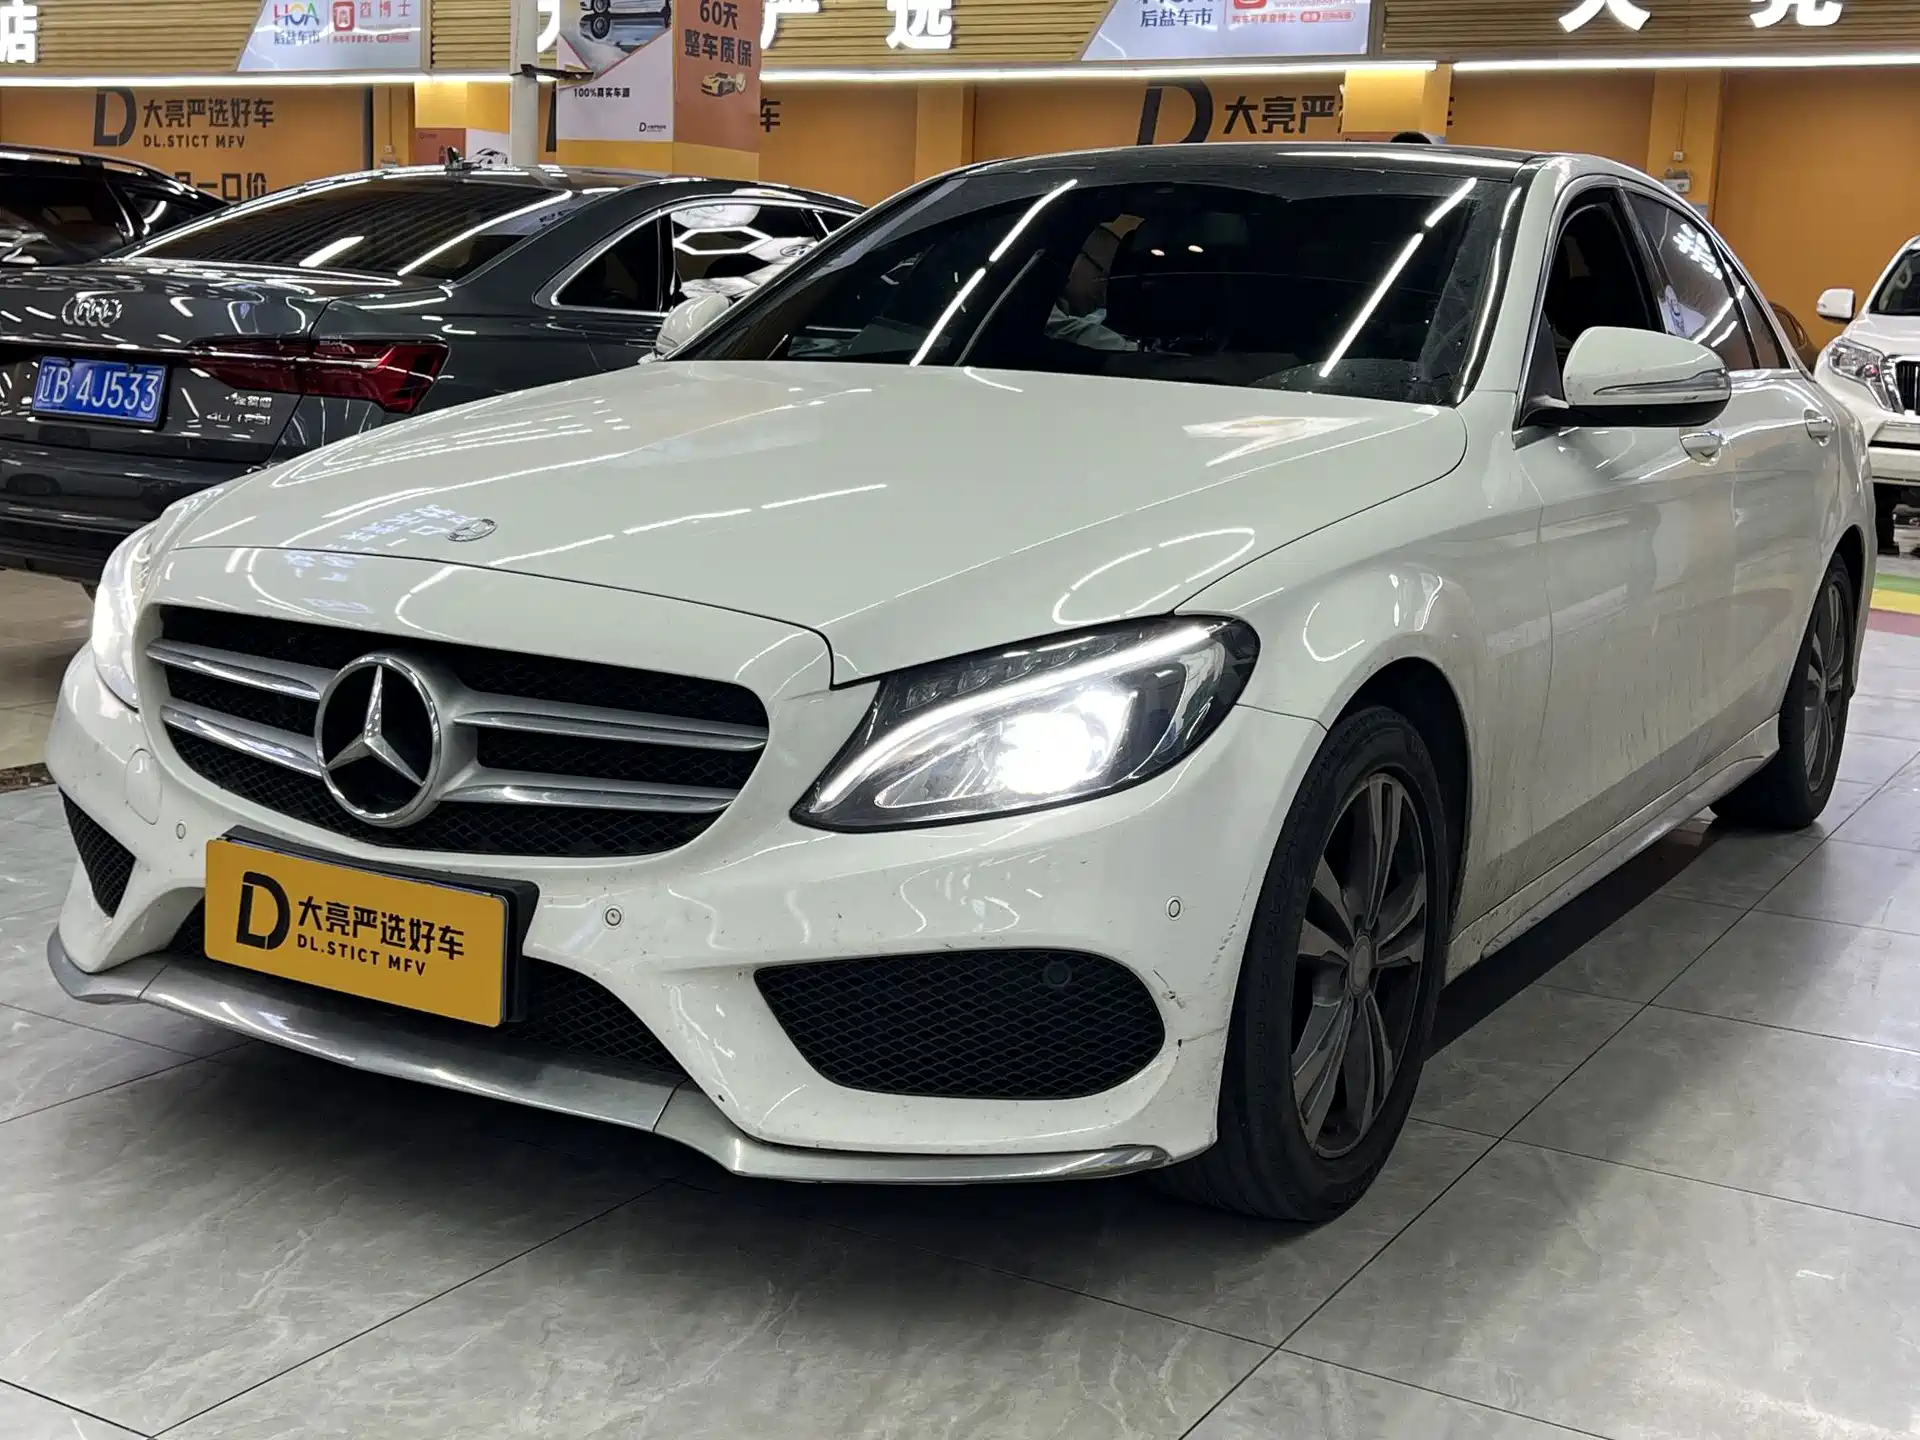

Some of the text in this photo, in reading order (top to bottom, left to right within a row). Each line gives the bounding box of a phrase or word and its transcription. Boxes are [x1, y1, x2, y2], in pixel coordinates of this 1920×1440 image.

[1140, 8, 1213, 28] 后盐车市
[684, 29, 752, 67] 整车质保
[143, 99, 275, 128] 大亮严选好车
[1223, 96, 1343, 134] 大亮严
[143, 134, 245, 148] DL.STICT MFV
[236, 871, 465, 960] D 大亮严选好车
[297, 934, 427, 976] DL.STICT MFV
